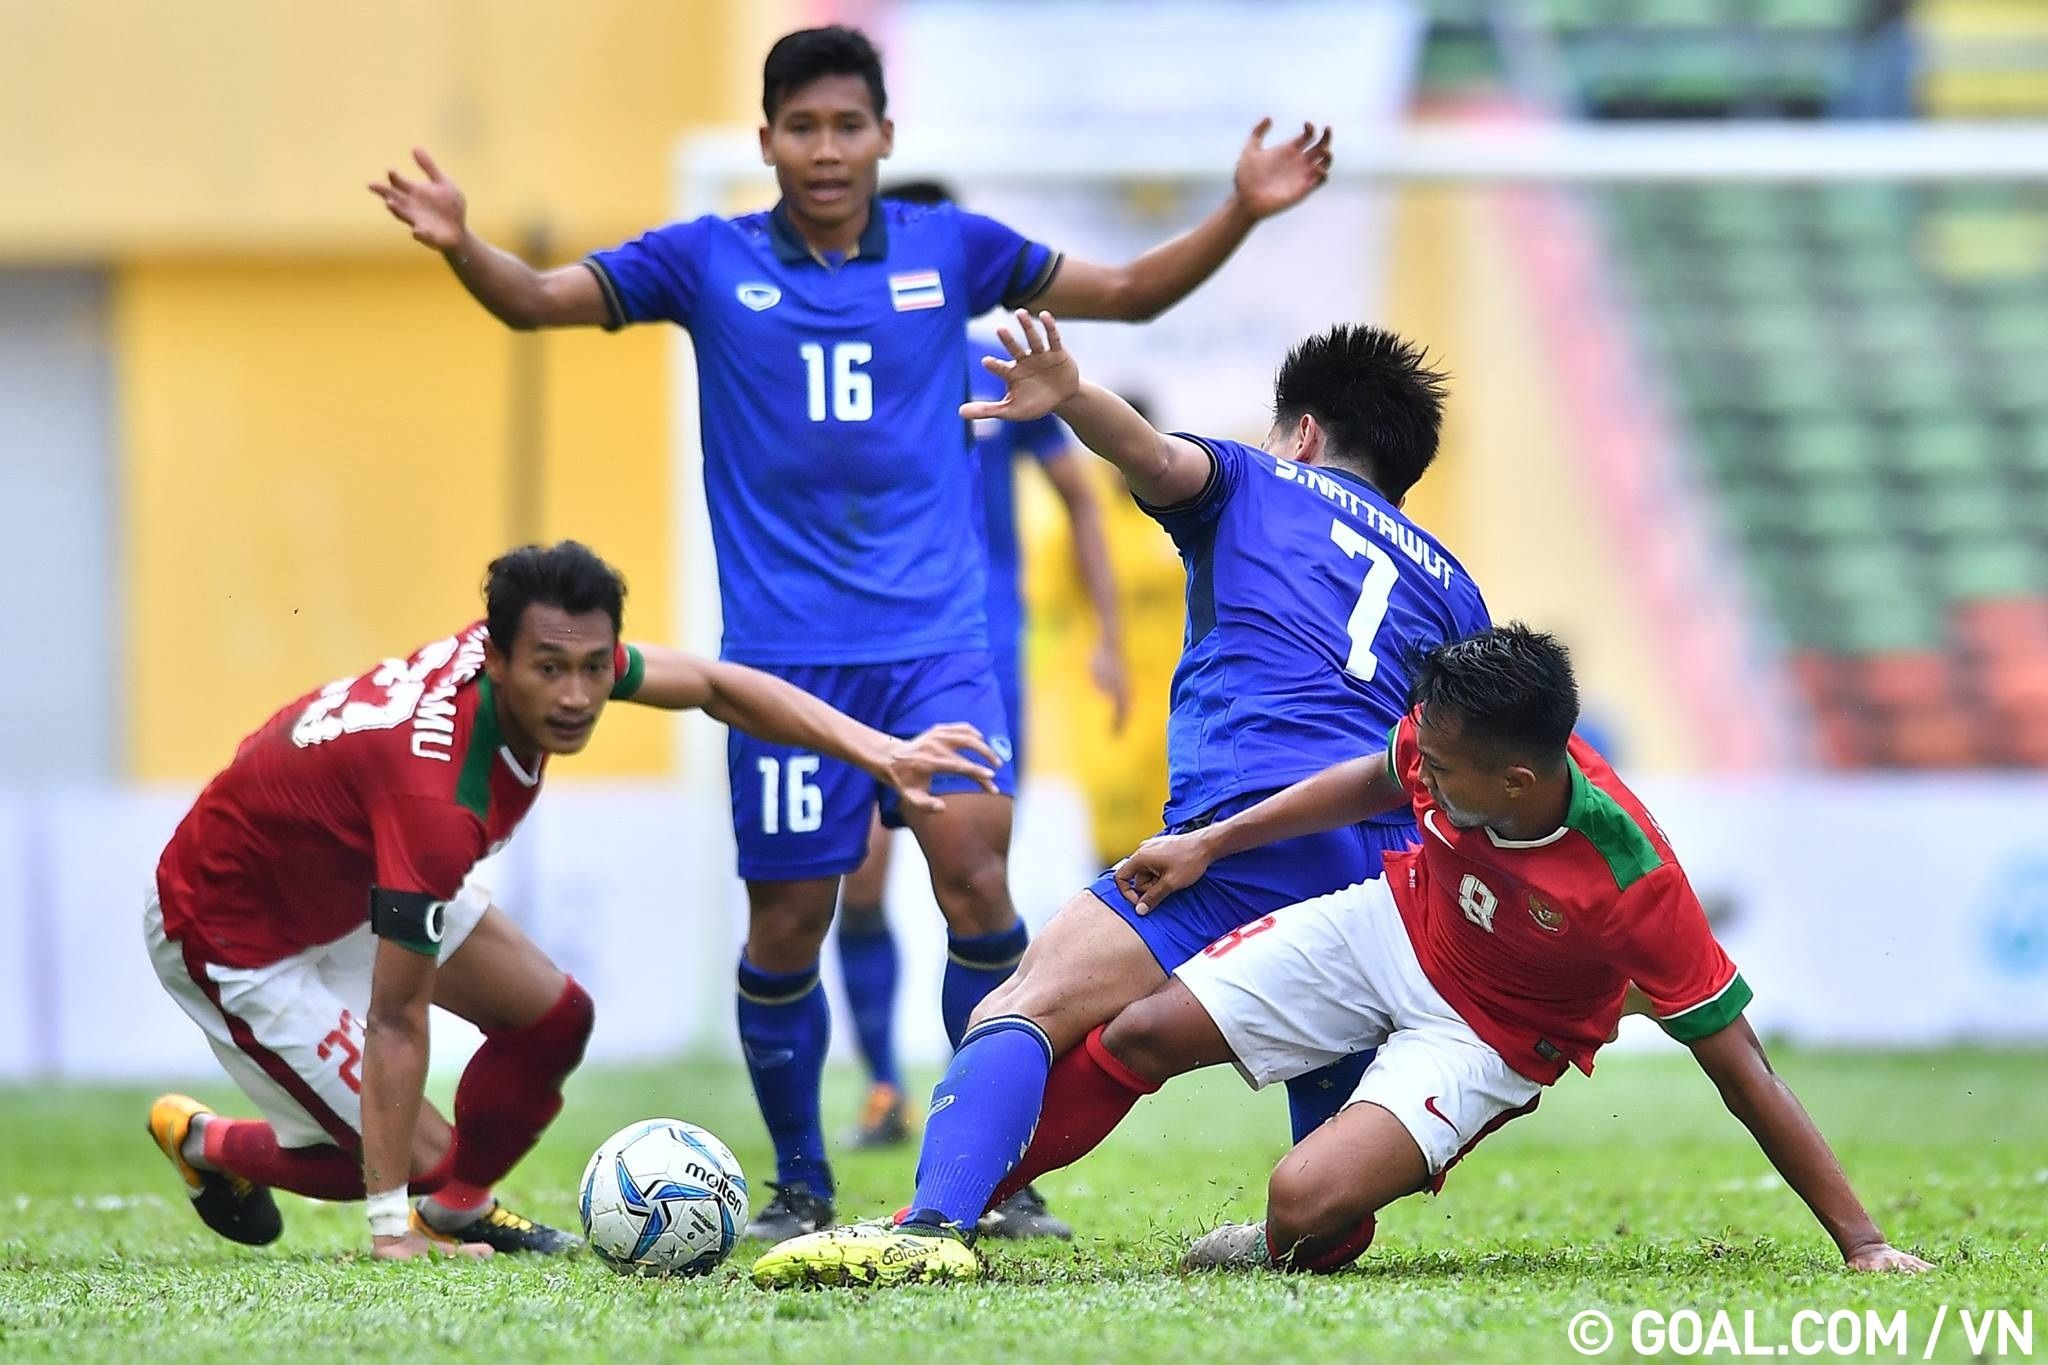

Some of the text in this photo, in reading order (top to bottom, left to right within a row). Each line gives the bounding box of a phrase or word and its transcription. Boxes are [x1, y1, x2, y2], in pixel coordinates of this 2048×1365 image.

[801, 342, 872, 421] 16
[1329, 518, 1400, 682] 7
[757, 755, 823, 834] 16
[685, 1162, 742, 1217] molten
